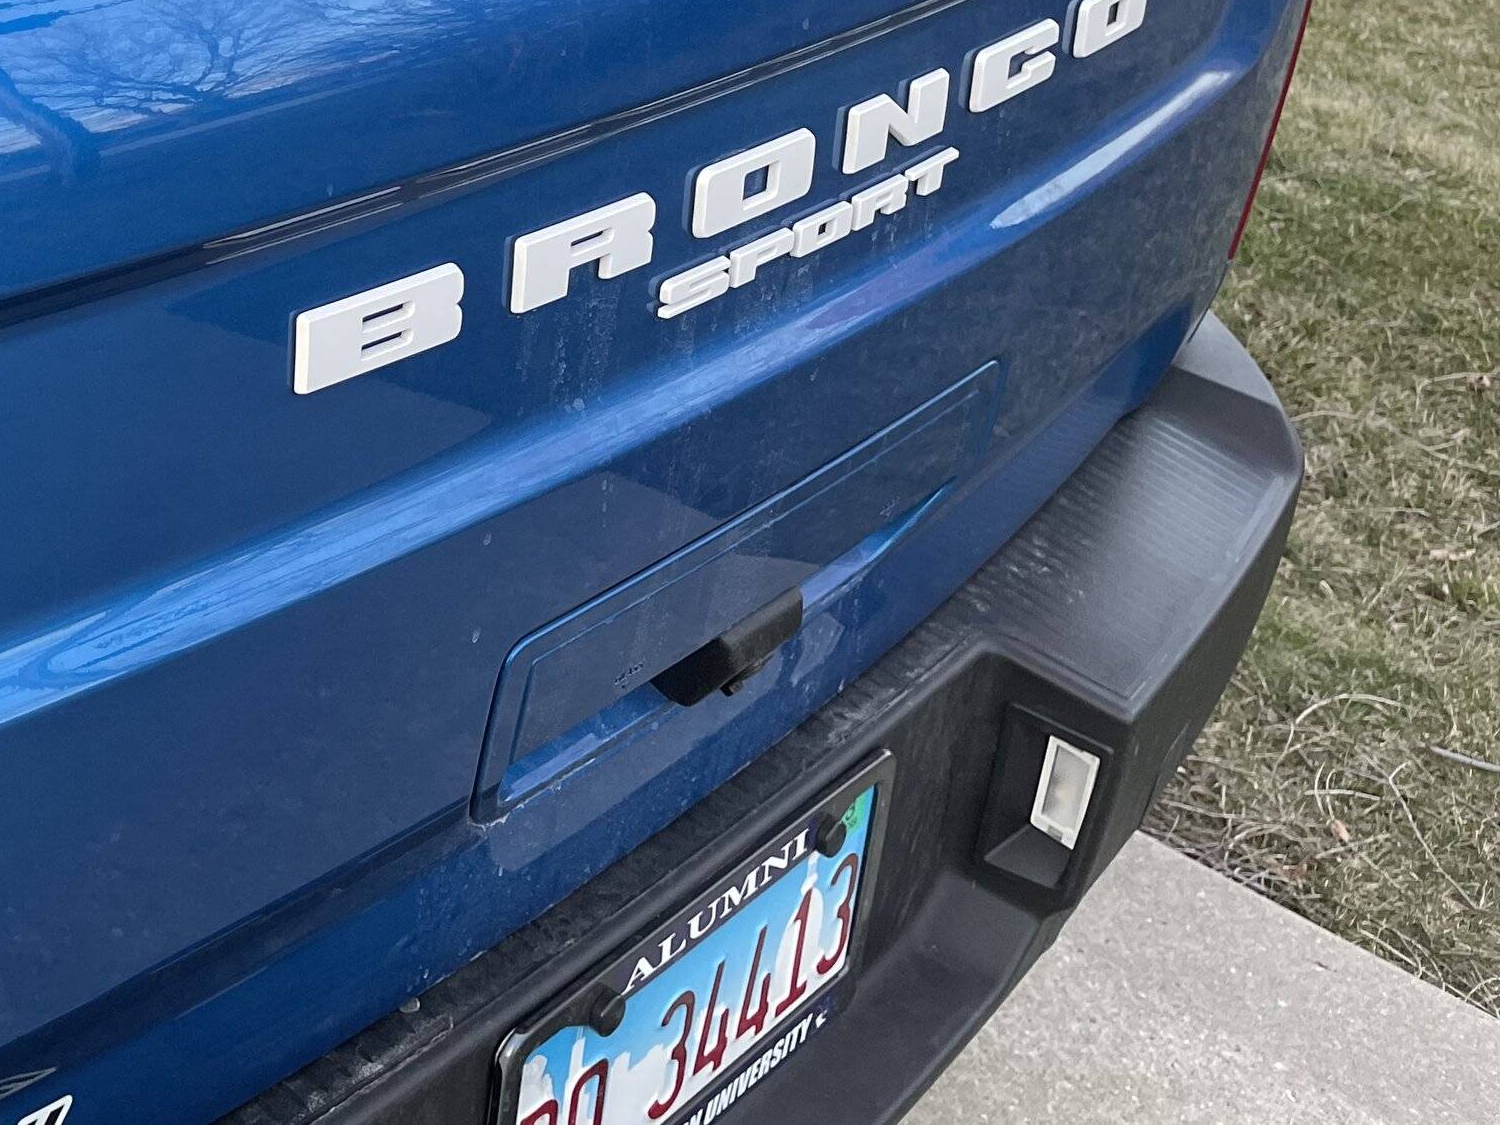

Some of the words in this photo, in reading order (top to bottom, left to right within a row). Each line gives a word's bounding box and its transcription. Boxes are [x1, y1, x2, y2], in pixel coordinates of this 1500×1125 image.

[656, 146, 960, 320] SPORT
[622, 827, 810, 996] ALUMNI
[647, 852, 859, 1120] 34413
[703, 1012, 814, 1125] UNIVERSITY
